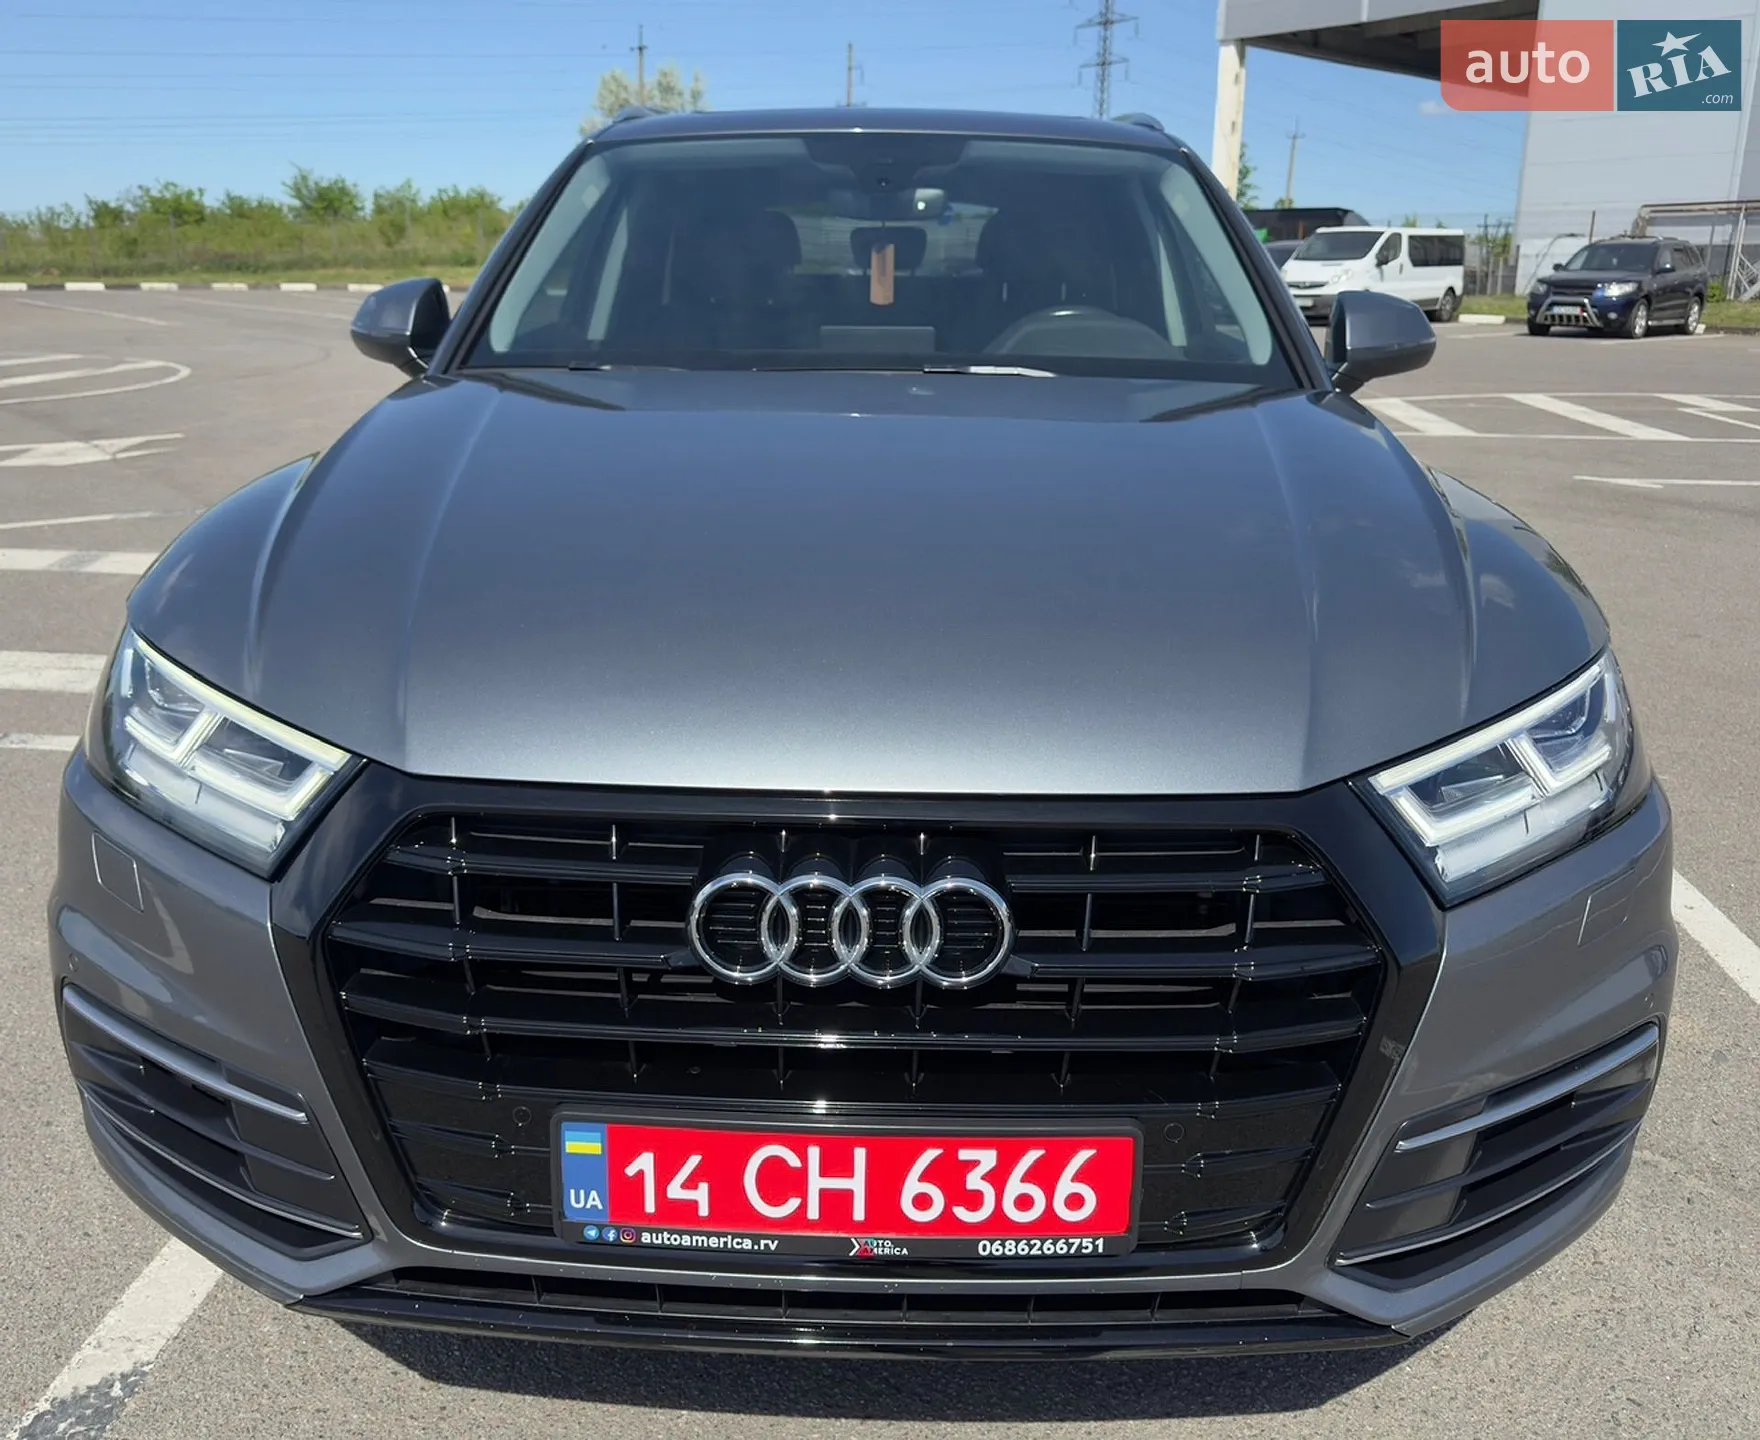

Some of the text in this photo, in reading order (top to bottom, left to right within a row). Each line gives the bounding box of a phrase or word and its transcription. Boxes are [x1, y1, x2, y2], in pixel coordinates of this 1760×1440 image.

[624, 1144, 1098, 1223] 14 CH 6366
[569, 1188, 603, 1210] UA
[640, 1230, 779, 1251] autoamerica.rv
[977, 1238, 1104, 1256] 0686266751
